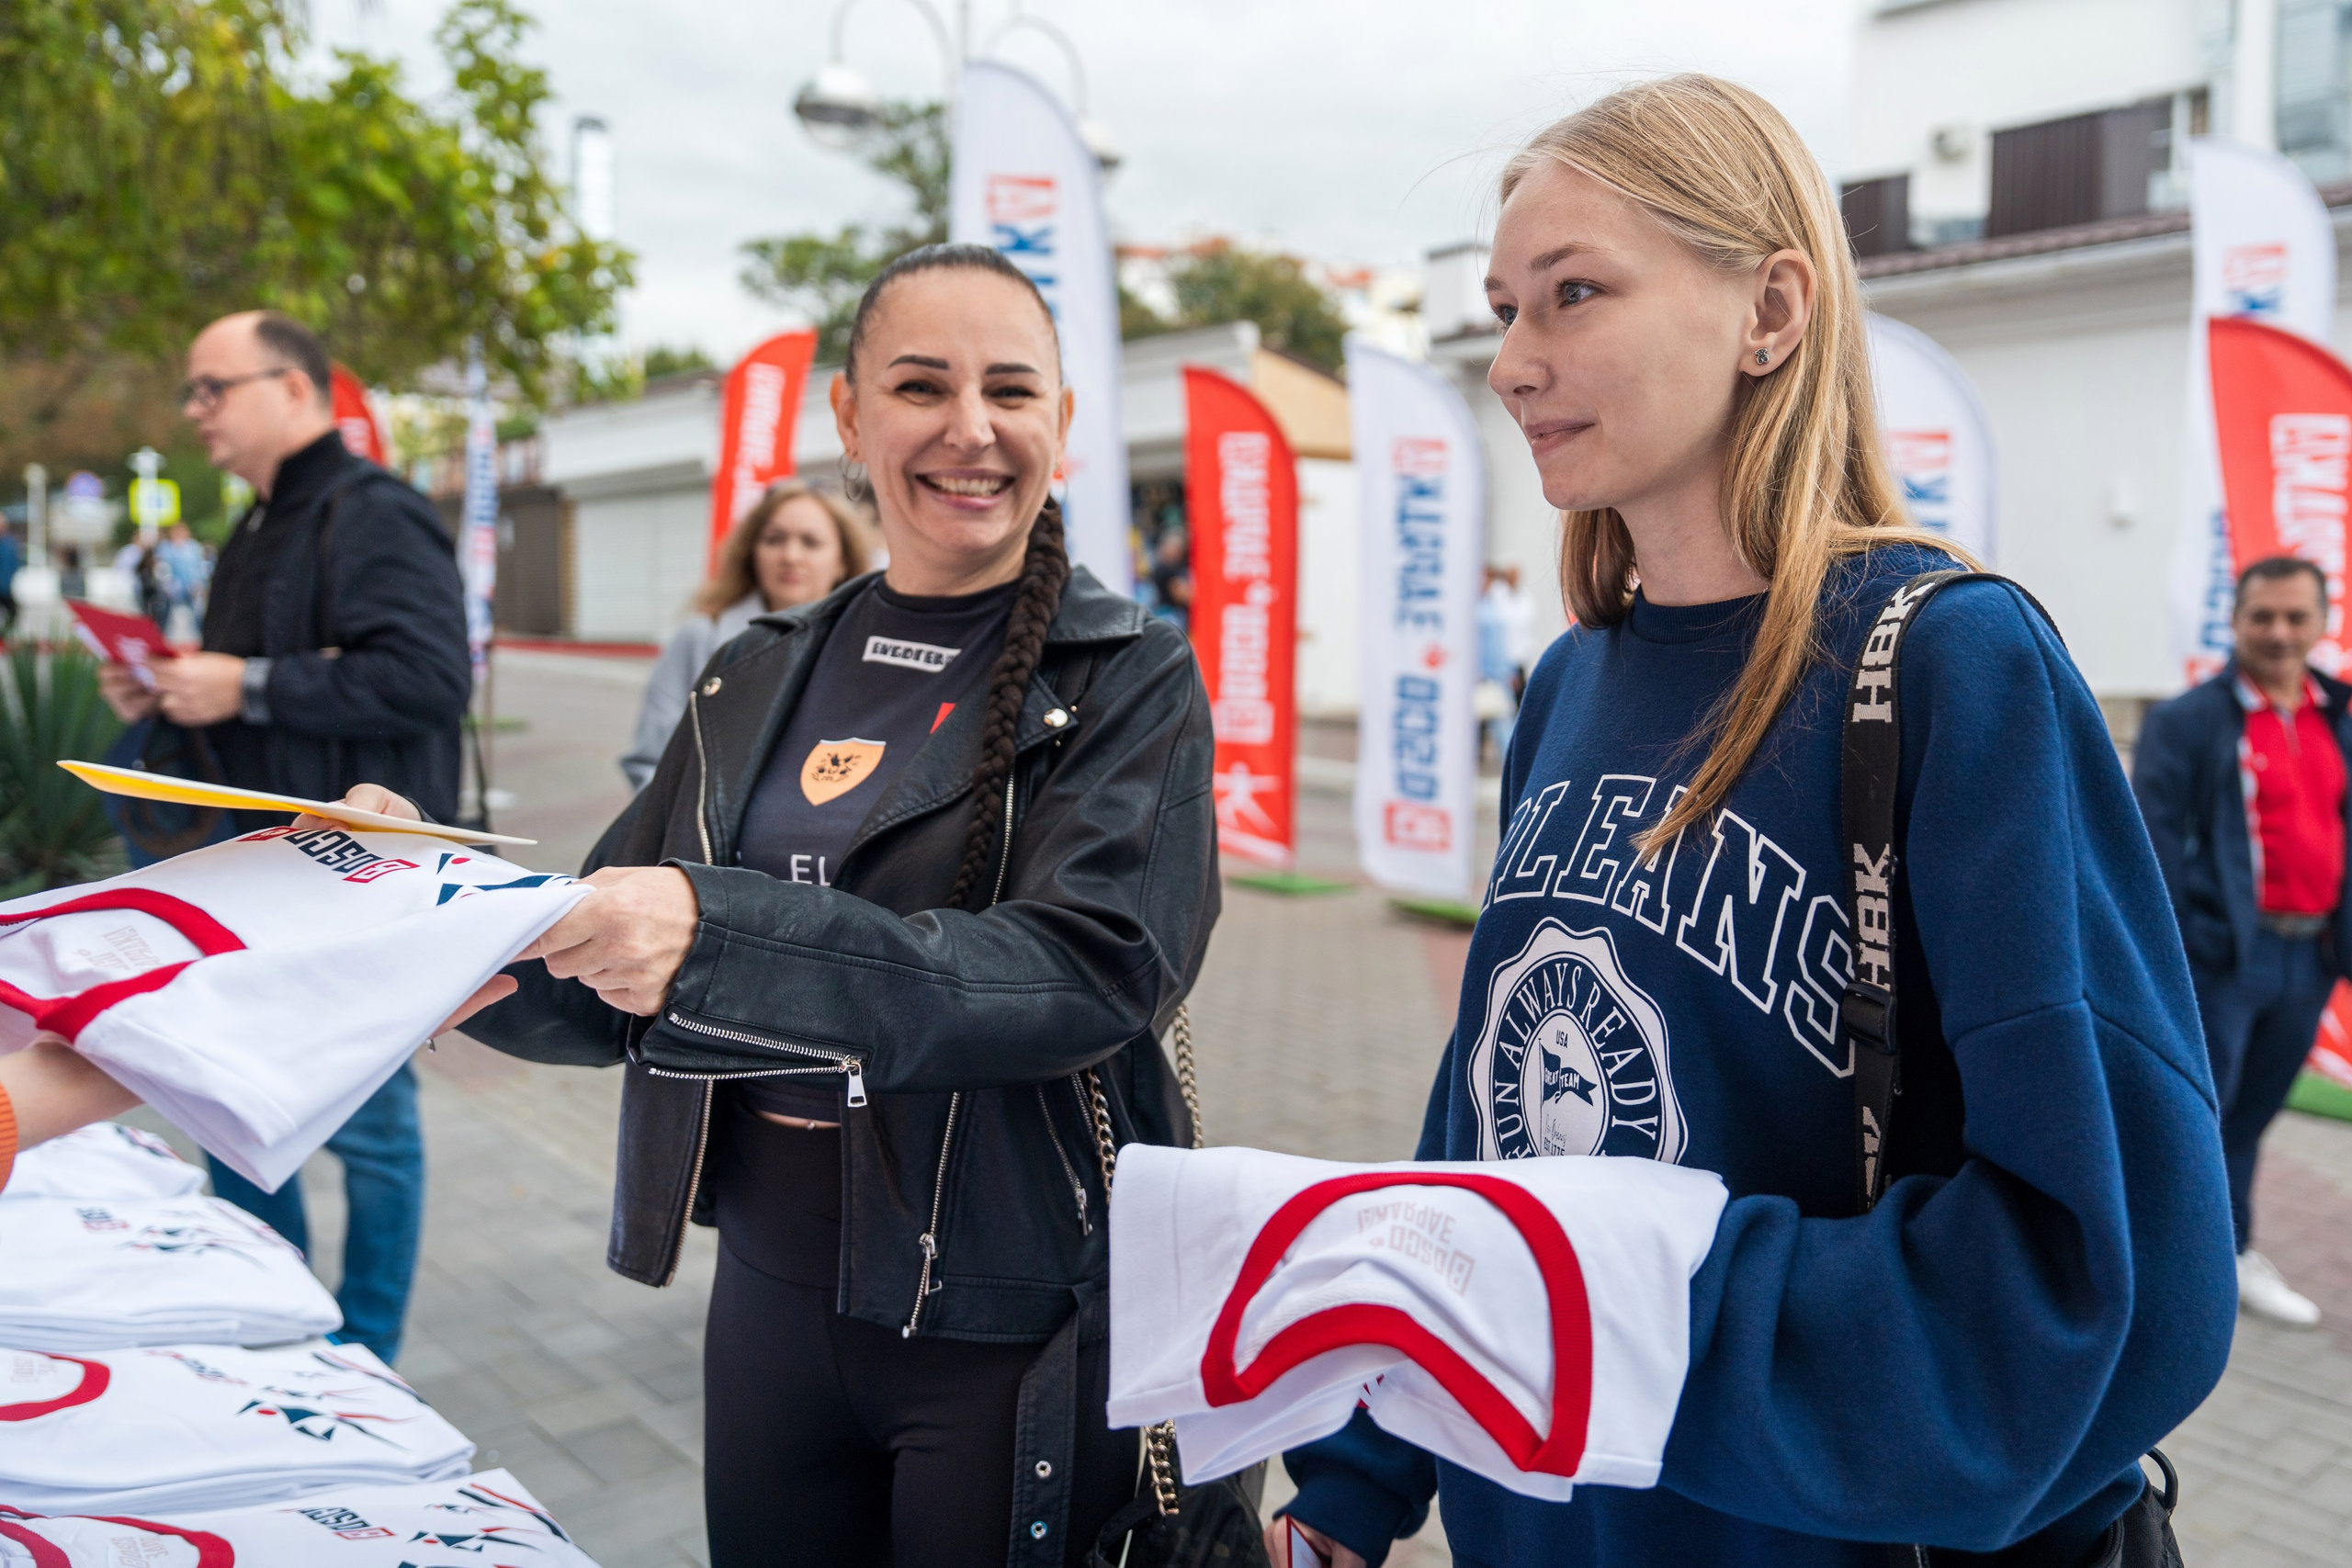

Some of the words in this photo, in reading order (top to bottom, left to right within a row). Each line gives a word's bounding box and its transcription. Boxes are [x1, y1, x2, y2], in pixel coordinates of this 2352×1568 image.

[1851, 582, 1935, 723] HBK
[1853, 843, 1891, 991] HBK
[1498, 963, 1582, 1071] ALWAYS
[1579, 981, 1659, 1141] READY
[1555, 1029, 1568, 1049] USA
[1559, 1072, 1580, 1090] TEAM
[1388, 1224, 1476, 1297] BOSCO
